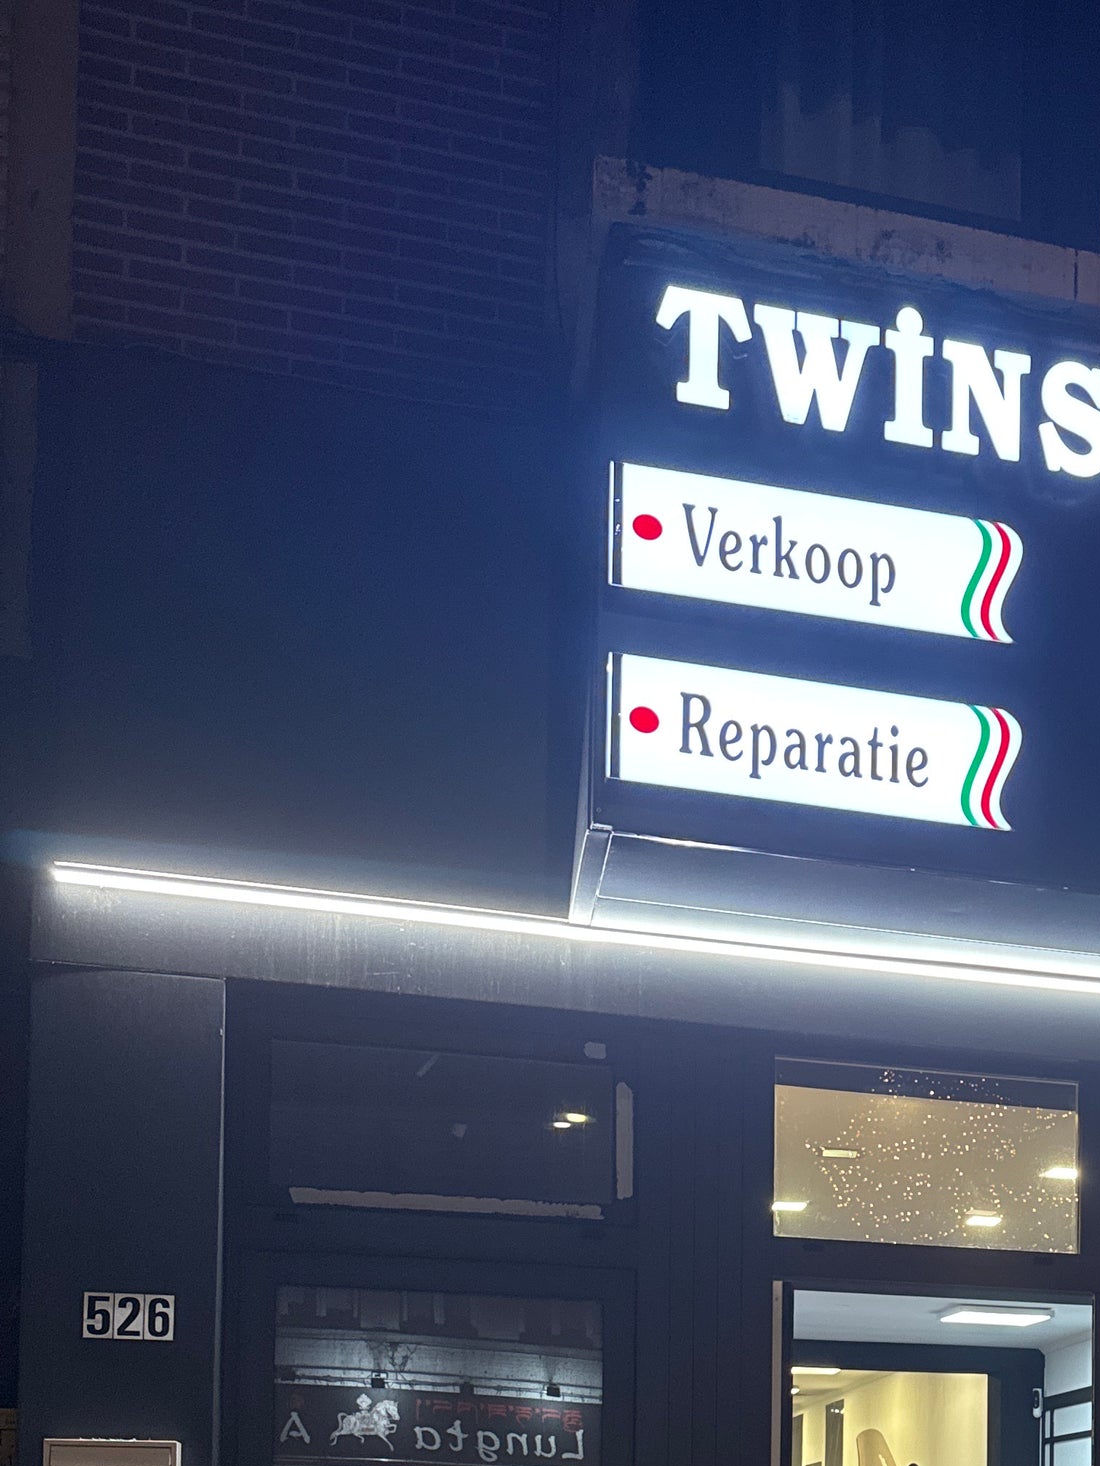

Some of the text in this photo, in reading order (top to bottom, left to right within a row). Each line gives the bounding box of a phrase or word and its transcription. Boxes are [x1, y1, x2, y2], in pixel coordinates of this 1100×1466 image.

[682, 502, 896, 607] Verkoop
[679, 691, 929, 788] Reparatie
[86, 1295, 171, 1338] 526
